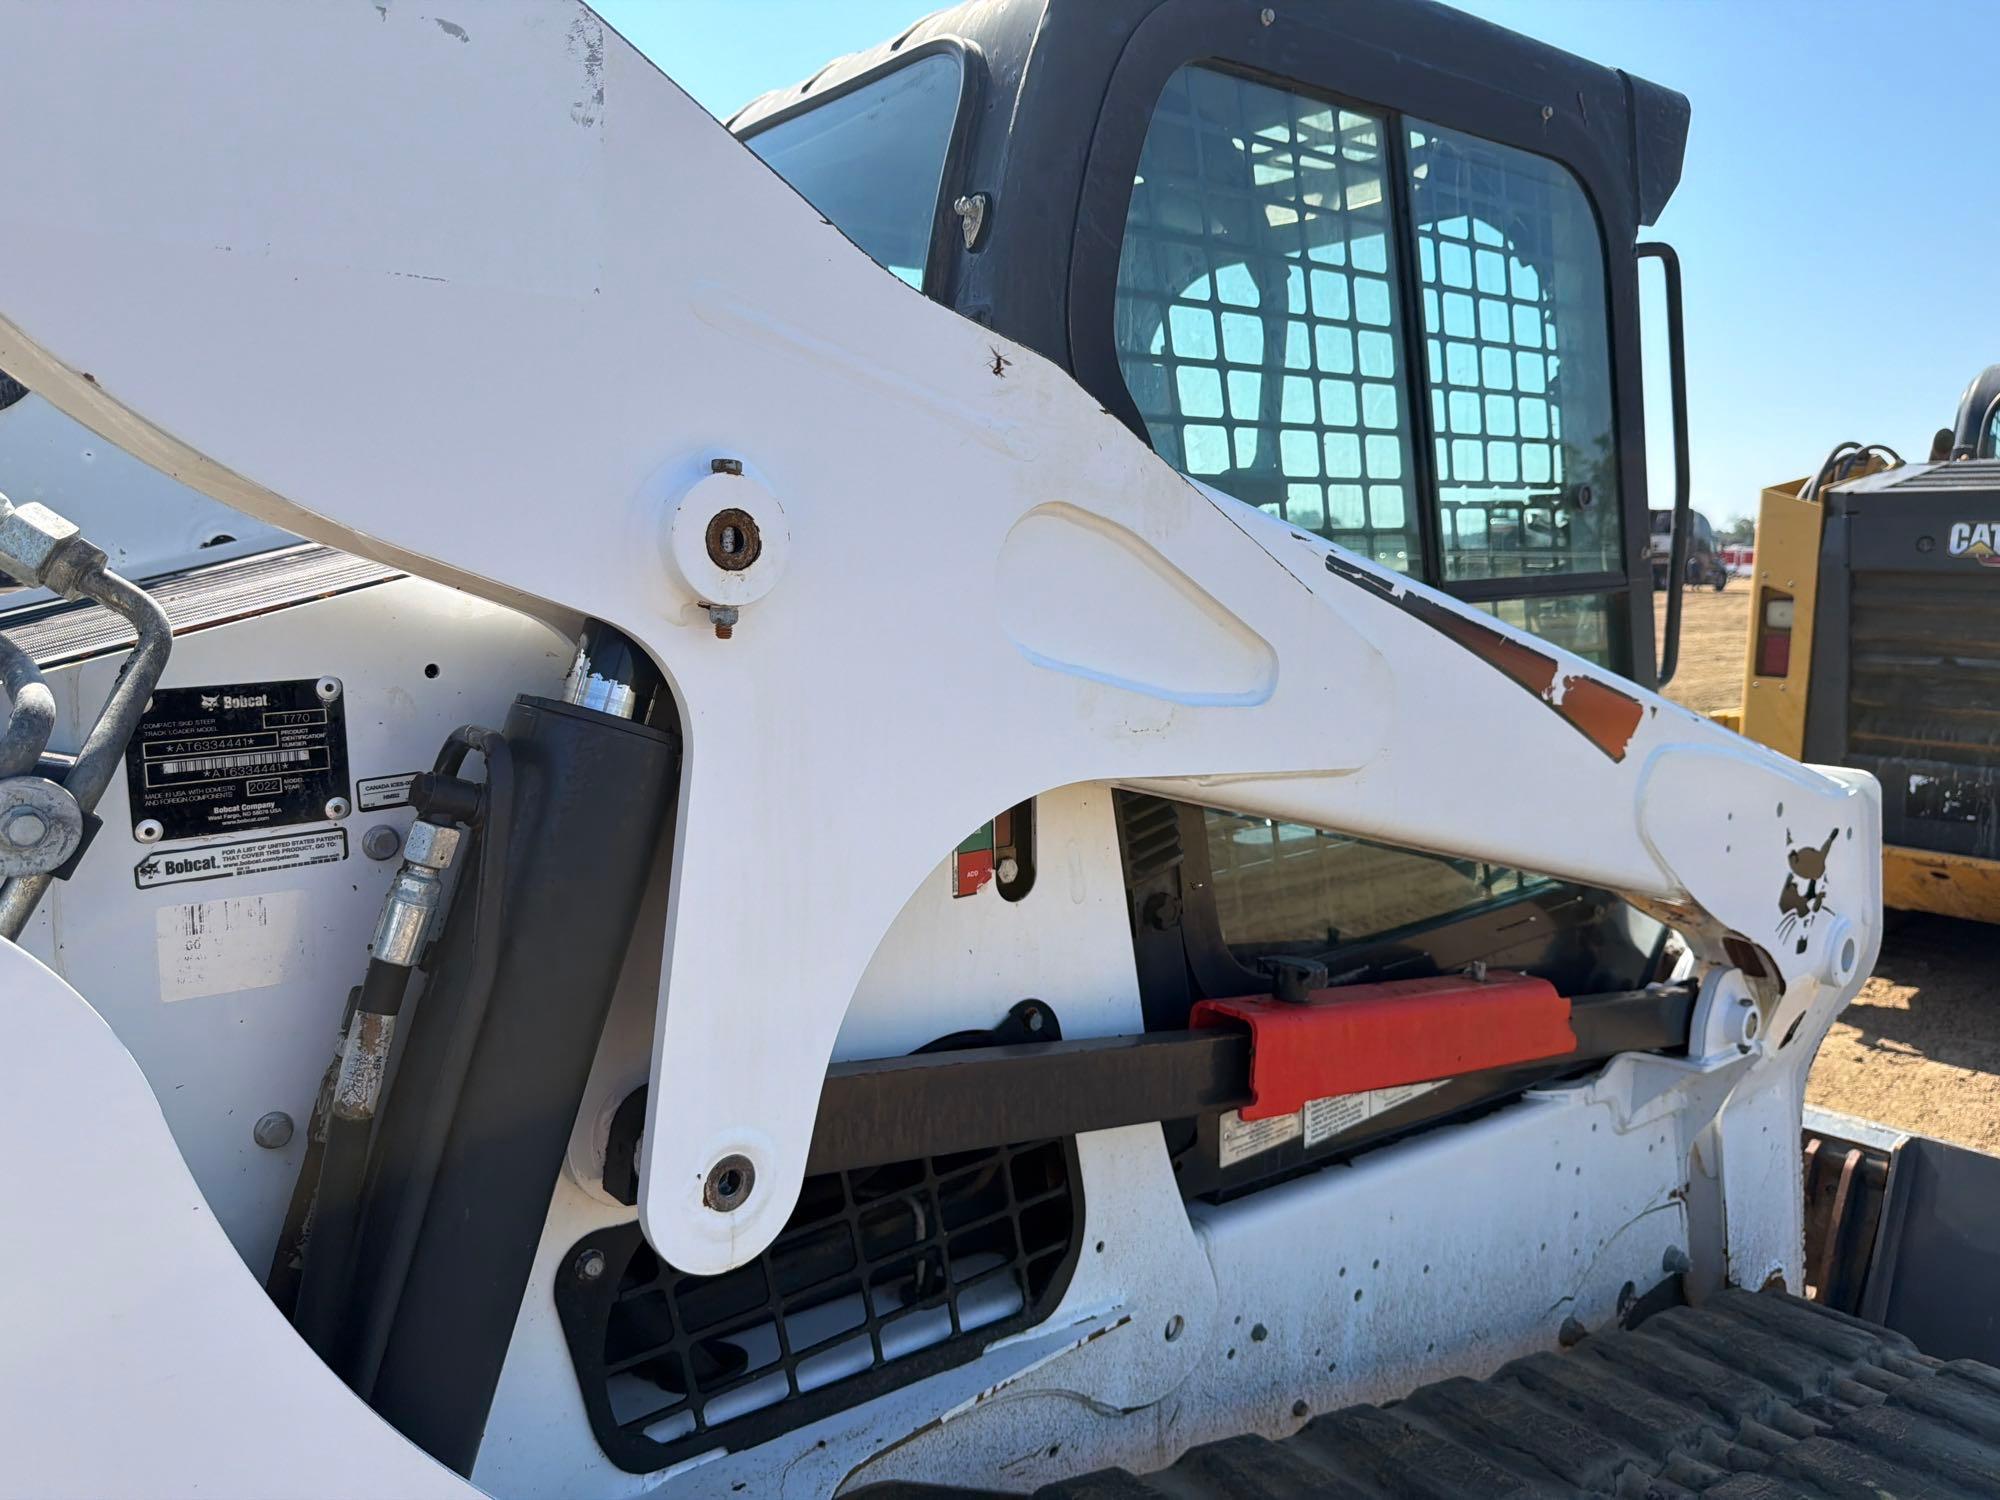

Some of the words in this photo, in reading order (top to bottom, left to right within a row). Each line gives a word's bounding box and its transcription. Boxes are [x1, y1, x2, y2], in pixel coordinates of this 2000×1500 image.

[223, 694, 268, 709] Bobcat
[143, 721, 176, 730] COMPACT
[195, 718, 216, 726] STEER
[283, 713, 310, 724] T770
[250, 781, 278, 792] 2022
[365, 783, 390, 791] CANADA
[213, 804, 240, 814] Bobcat
[241, 802, 276, 812] Company
[268, 841, 290, 850] UNITED
[291, 838, 315, 846] STATES
[241, 851, 264, 860] COVER
[266, 849, 280, 857] THIS
